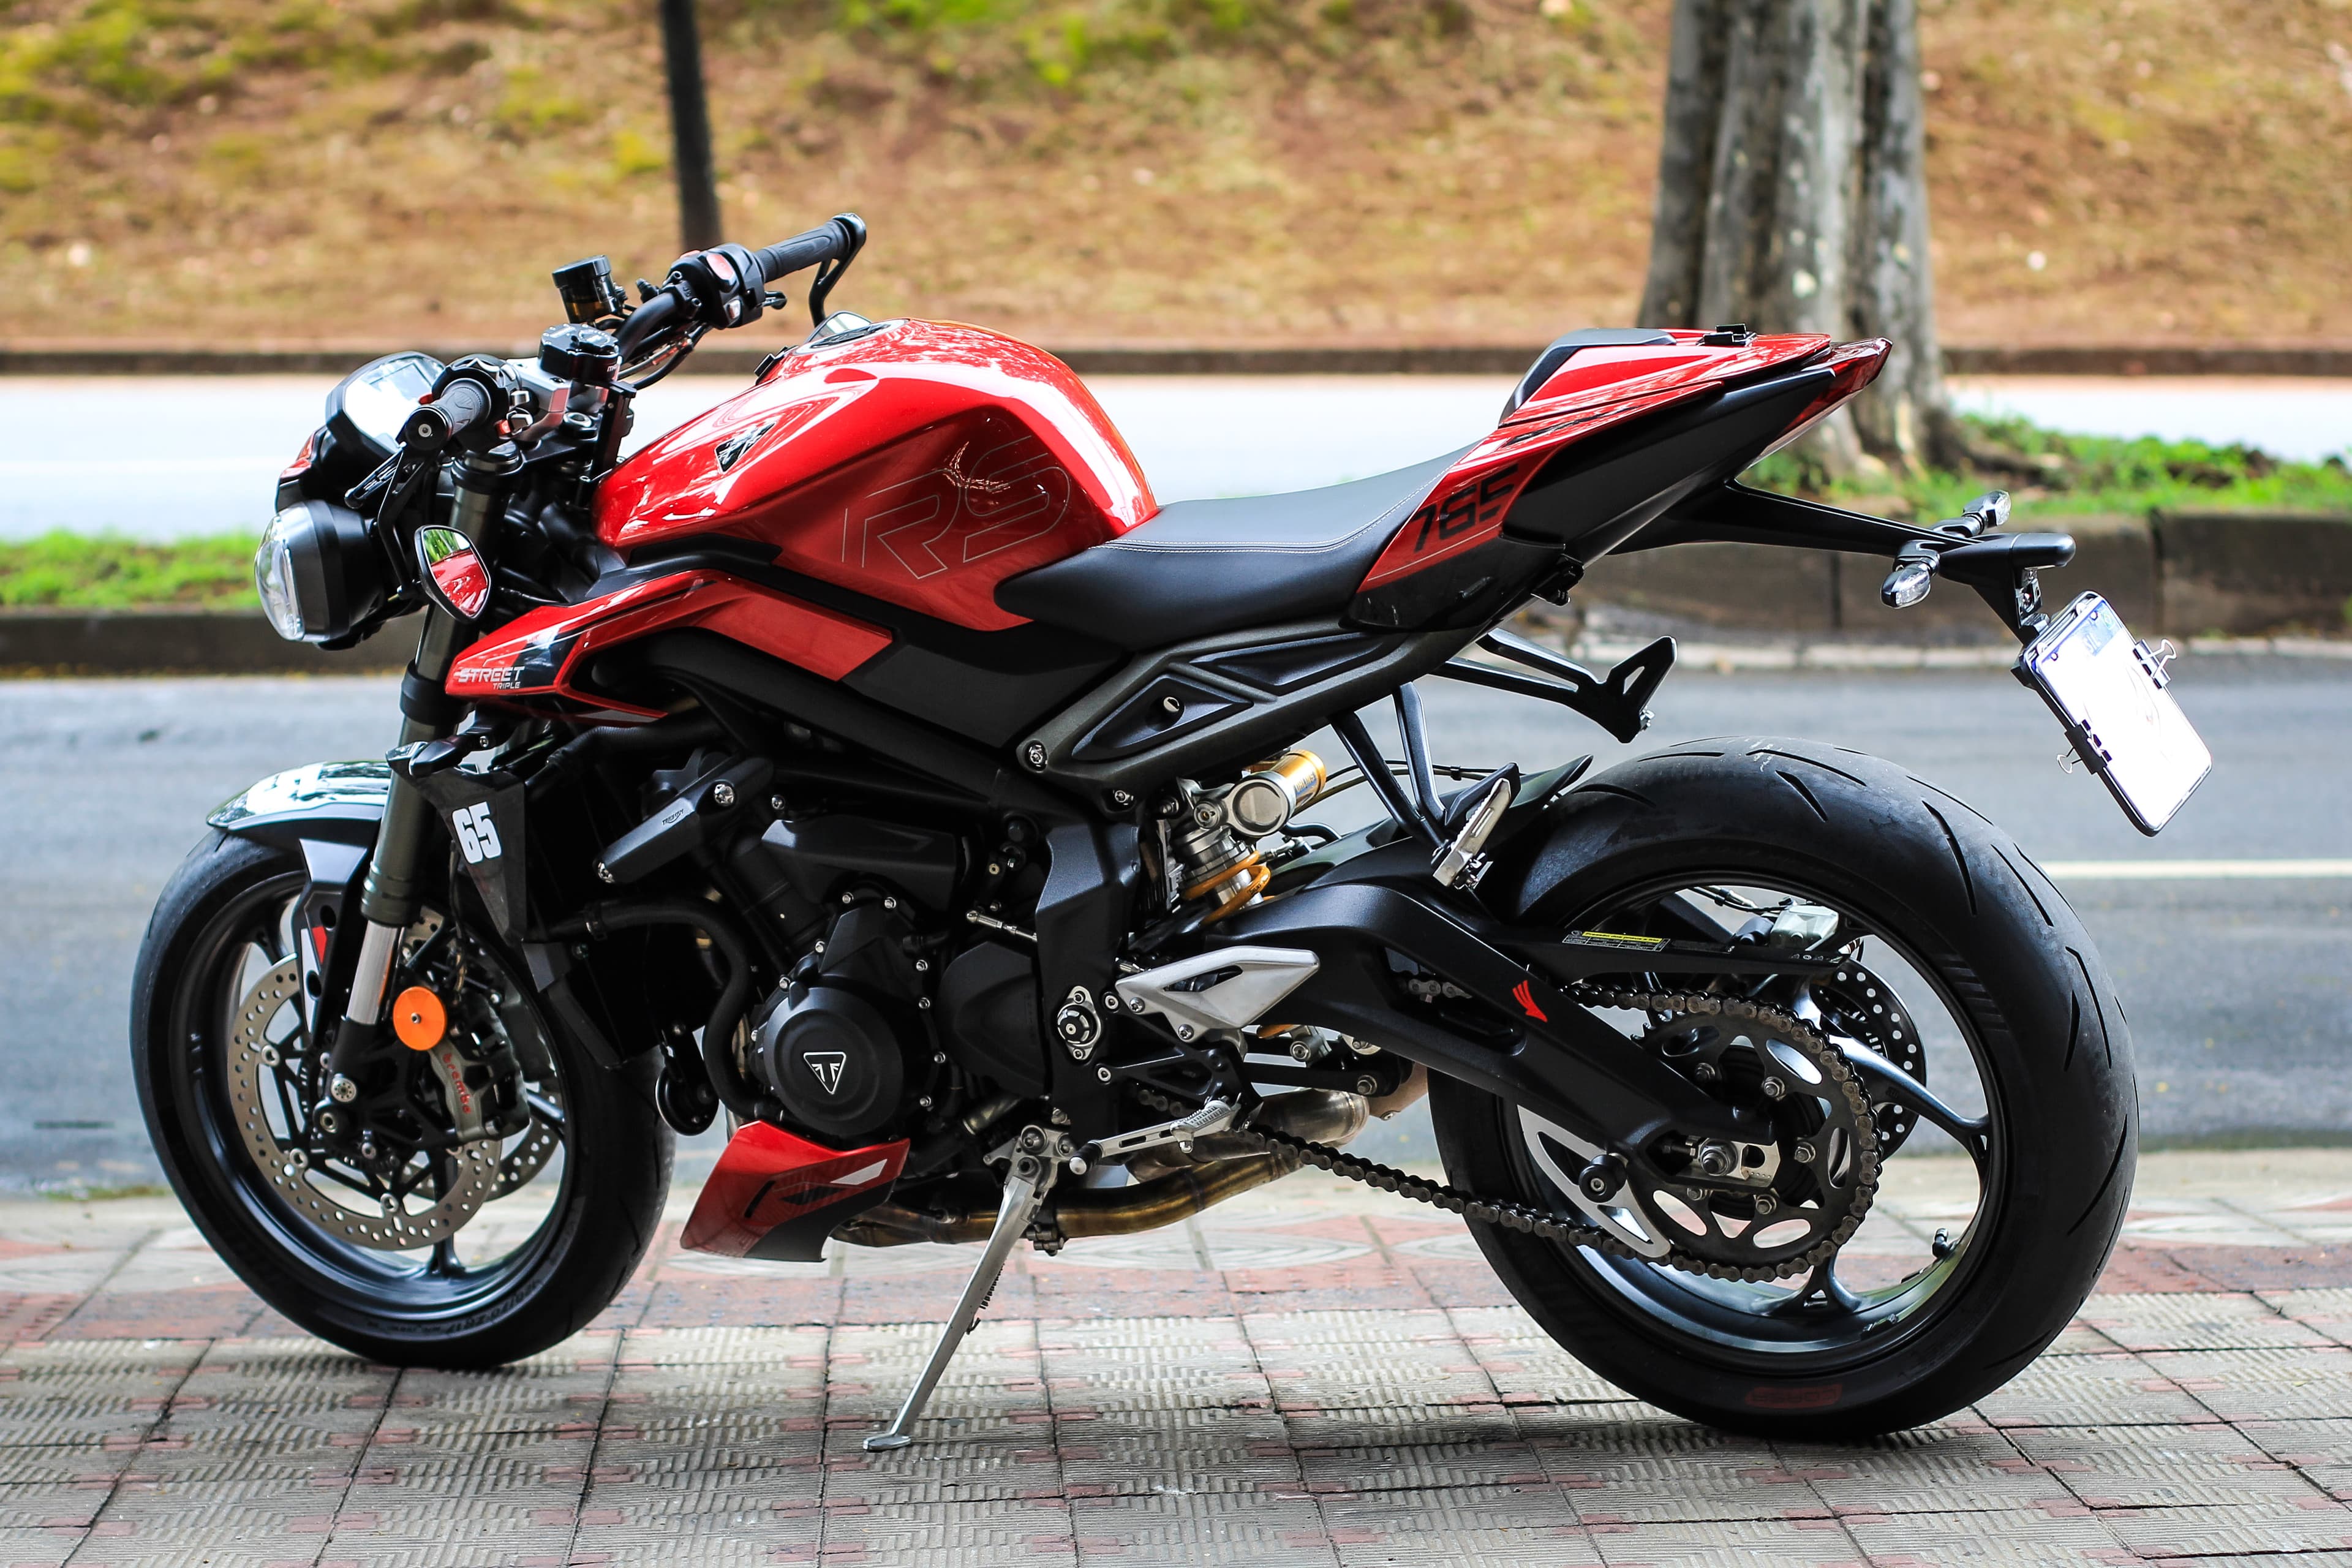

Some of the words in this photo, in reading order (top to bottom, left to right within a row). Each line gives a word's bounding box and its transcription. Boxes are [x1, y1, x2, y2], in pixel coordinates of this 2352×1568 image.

[842, 435, 1071, 579] RS
[1411, 463, 1518, 553] 765
[454, 666, 525, 682] STREET
[492, 681, 521, 690] TRIPLE
[452, 801, 502, 864] 65
[442, 1052, 471, 1114] brembo
